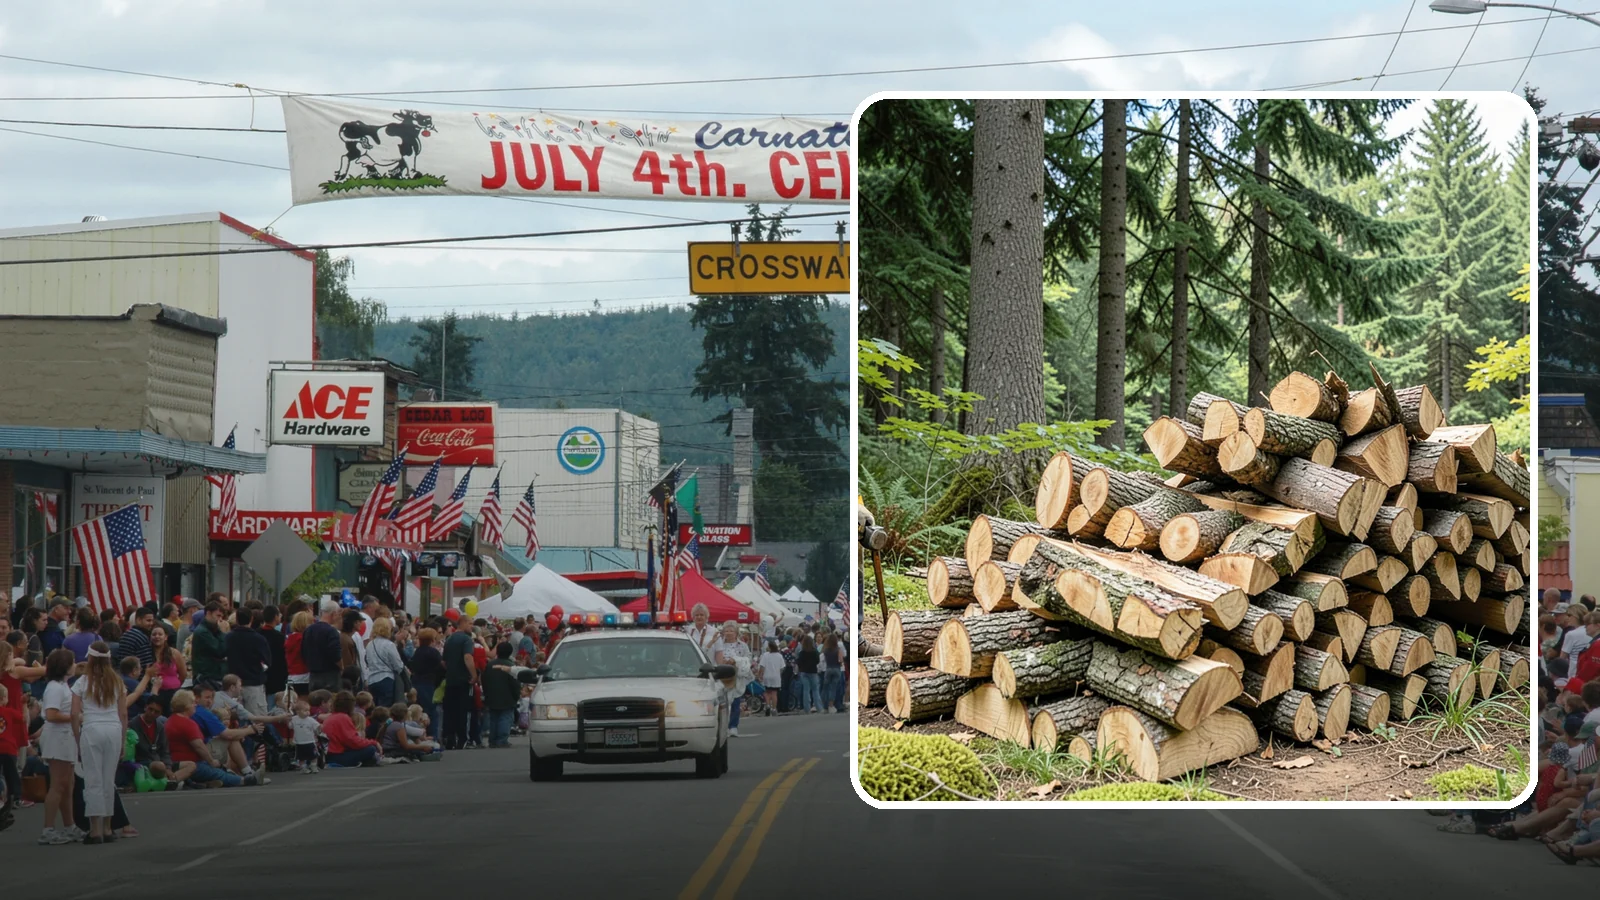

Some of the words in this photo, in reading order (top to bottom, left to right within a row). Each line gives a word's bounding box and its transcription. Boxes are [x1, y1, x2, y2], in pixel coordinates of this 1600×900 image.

[695, 121, 850, 150] Carnat
[481, 141, 605, 192] JULY
[632, 150, 746, 198] 4th.
[696, 254, 850, 280] CROSSWA
[283, 380, 373, 420] ACE
[406, 409, 452, 422] CEDAR
[461, 409, 485, 422] LOG
[283, 421, 370, 436] Hardware
[83, 485, 94, 494] St.
[96, 485, 124, 495] Vincent
[126, 486, 136, 495] de
[138, 486, 155, 495] Paul
[688, 527, 741, 535] CRNATION
[700, 535, 730, 543] GLASS
